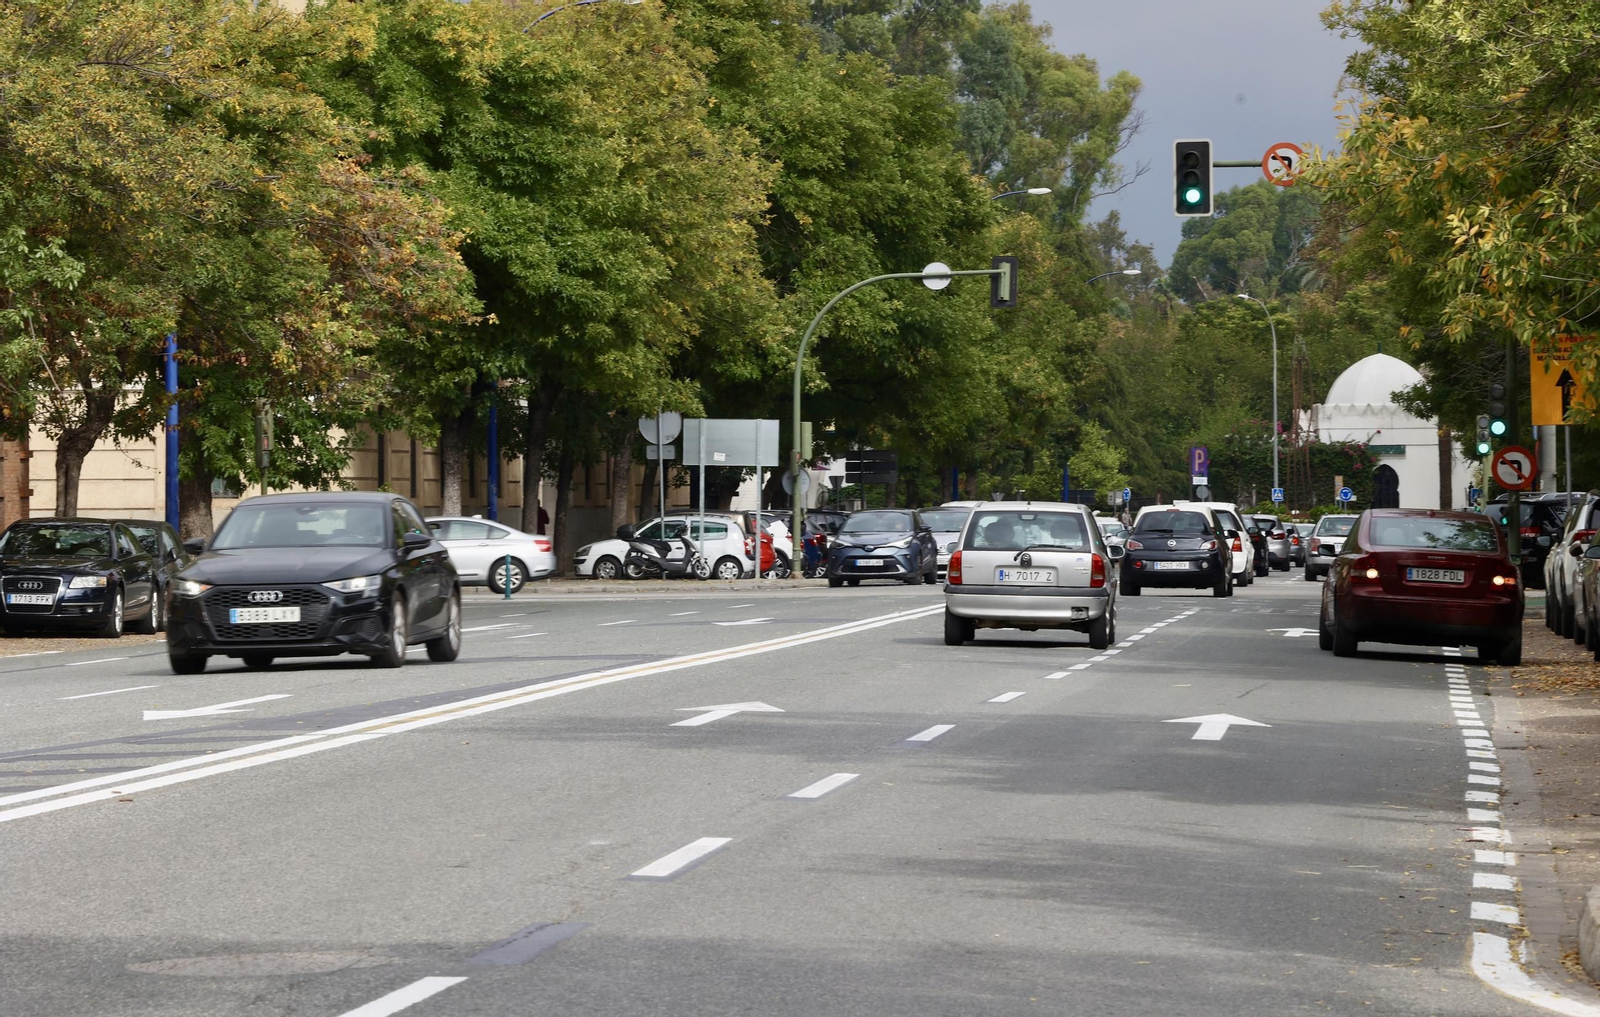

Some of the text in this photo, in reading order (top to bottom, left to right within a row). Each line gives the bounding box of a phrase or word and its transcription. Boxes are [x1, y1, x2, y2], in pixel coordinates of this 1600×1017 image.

[1195, 449, 1205, 471] P
[1004, 571, 1052, 581] H 7017 Z
[1416, 569, 1462, 581] 1828 FDL
[36, 595, 50, 603] FFK
